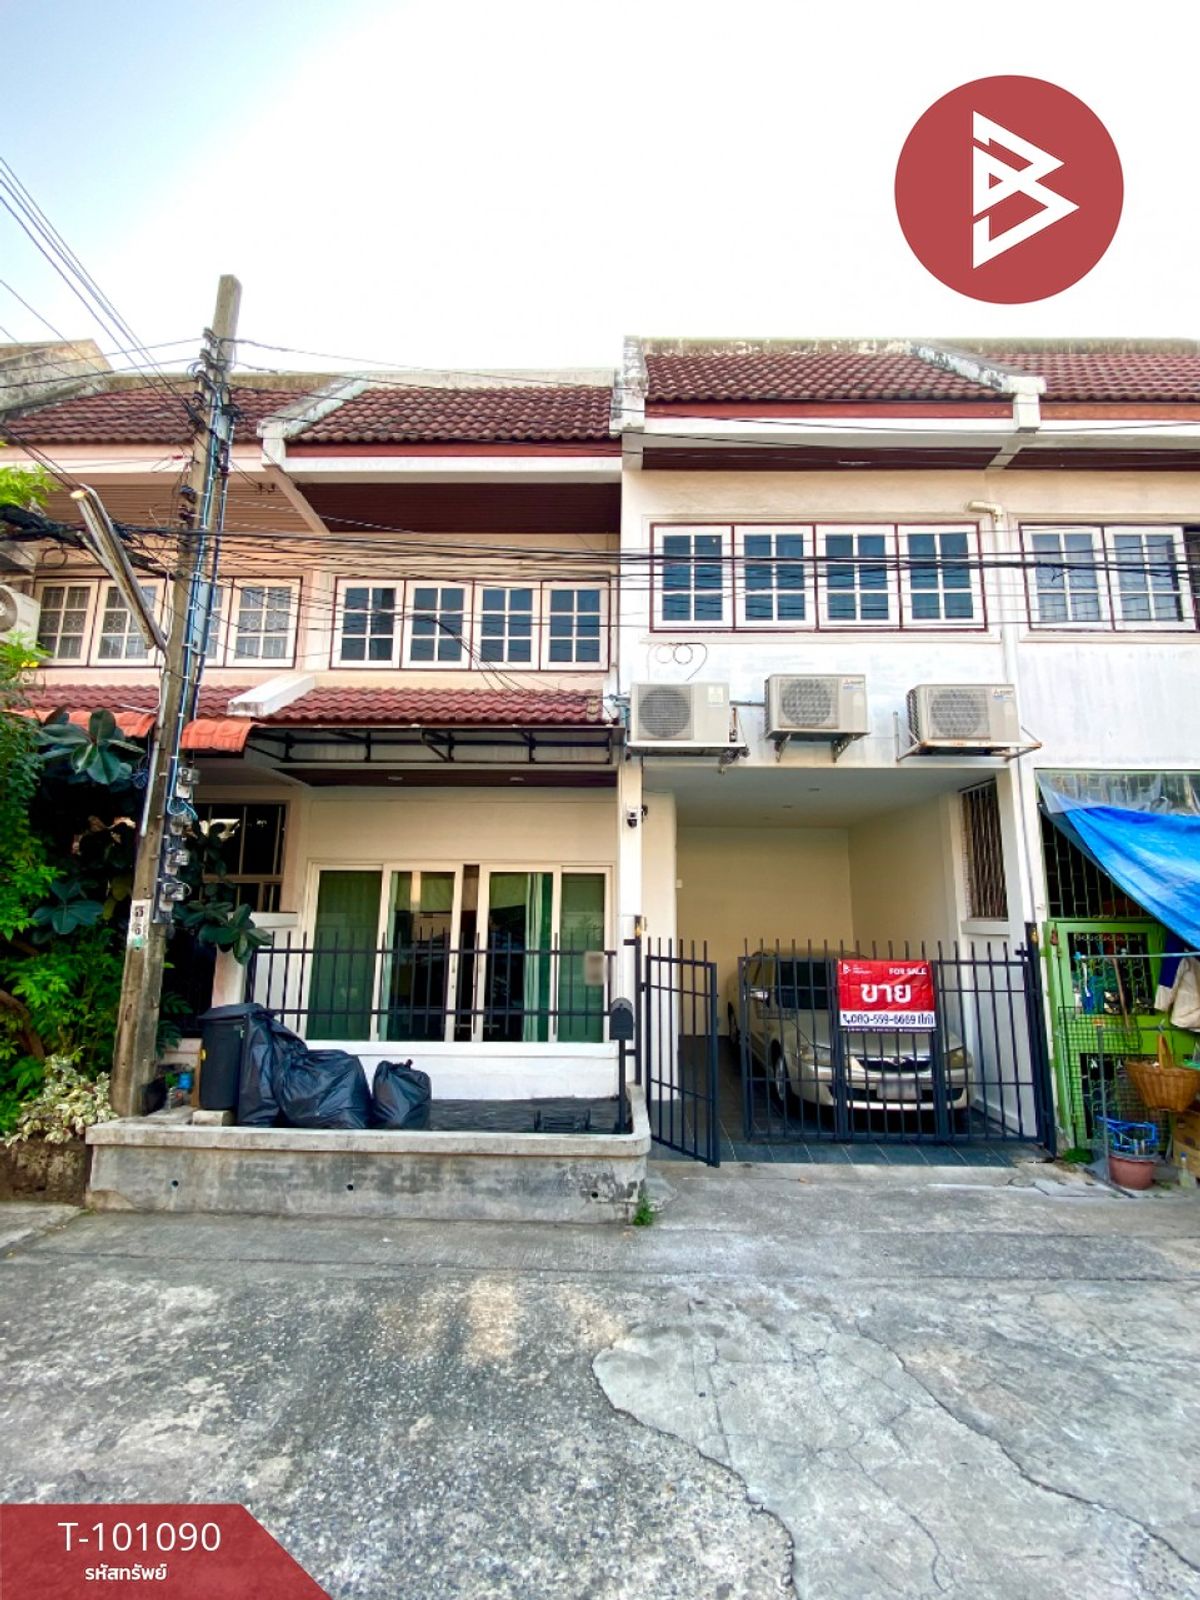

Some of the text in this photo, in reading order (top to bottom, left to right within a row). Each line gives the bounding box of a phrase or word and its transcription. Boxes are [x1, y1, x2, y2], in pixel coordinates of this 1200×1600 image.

[889, 967, 927, 975] FOR SALE
[860, 983, 912, 1004] ขาย
